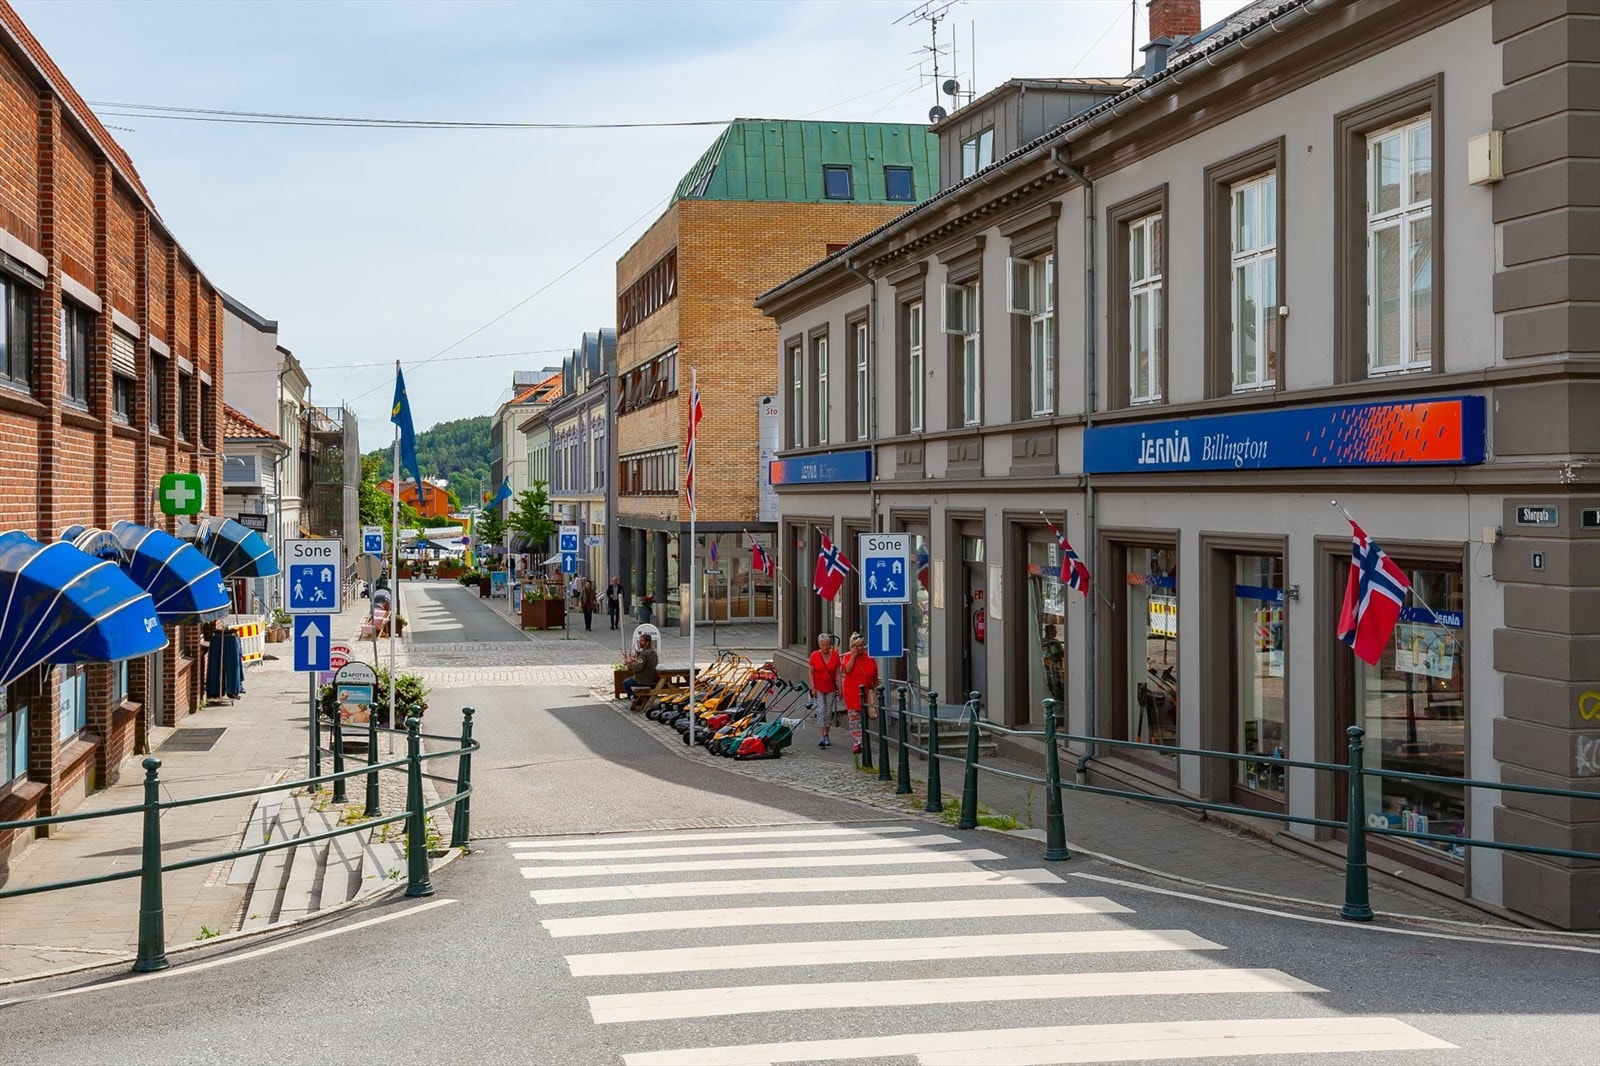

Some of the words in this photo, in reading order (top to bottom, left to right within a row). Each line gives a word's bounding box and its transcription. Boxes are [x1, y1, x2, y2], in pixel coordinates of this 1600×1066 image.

[1202, 434, 1268, 468] Billington
[1523, 508, 1549, 523] Storgata
[294, 544, 332, 557] Sone
[868, 538, 902, 551] Sone
[1535, 555, 1540, 567] 6
